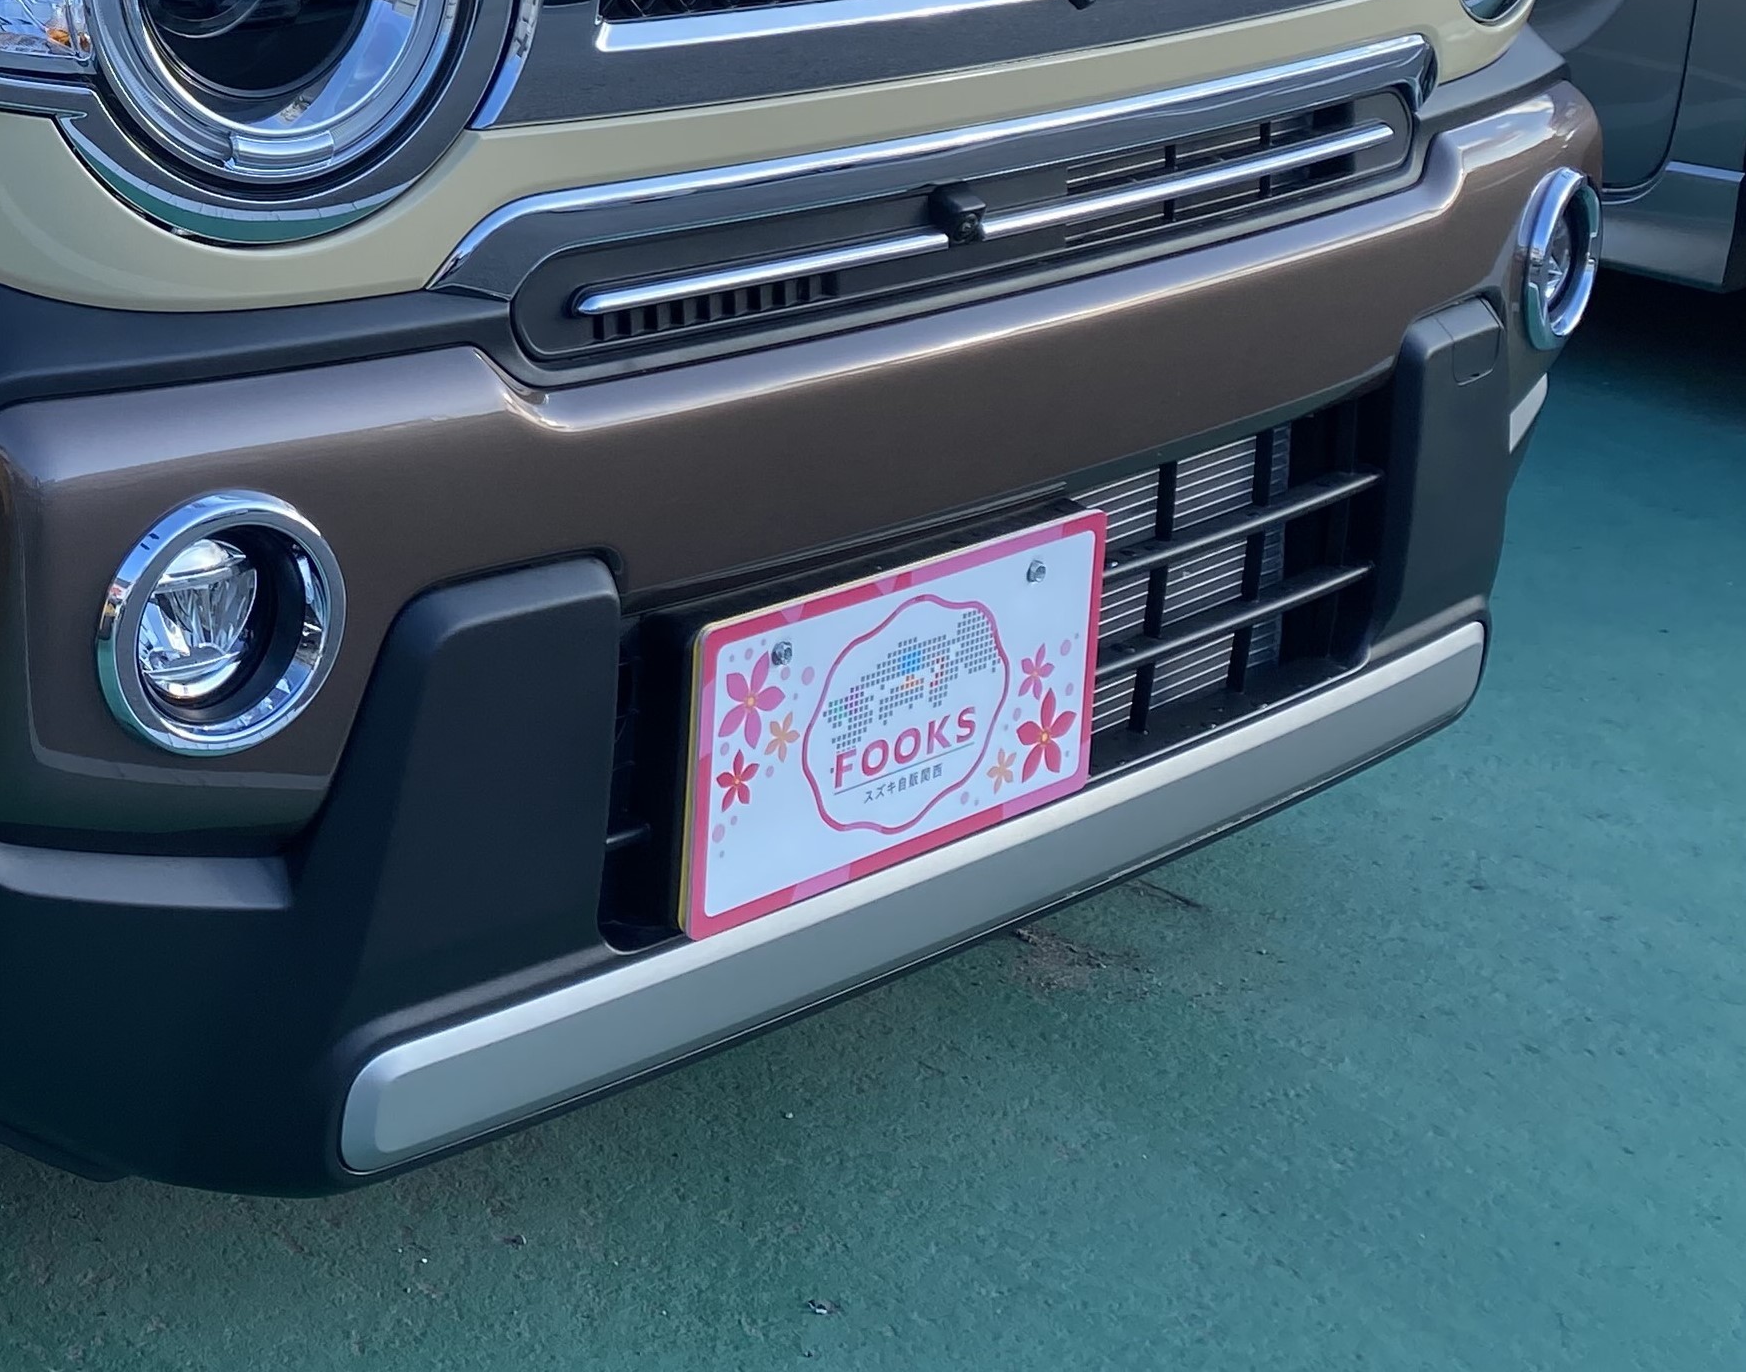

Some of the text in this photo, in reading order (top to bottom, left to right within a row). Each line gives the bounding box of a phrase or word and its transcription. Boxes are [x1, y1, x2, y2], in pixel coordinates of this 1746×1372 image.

[833, 705, 977, 790] FOOKS
[863, 762, 944, 804] スズキ自販関西
